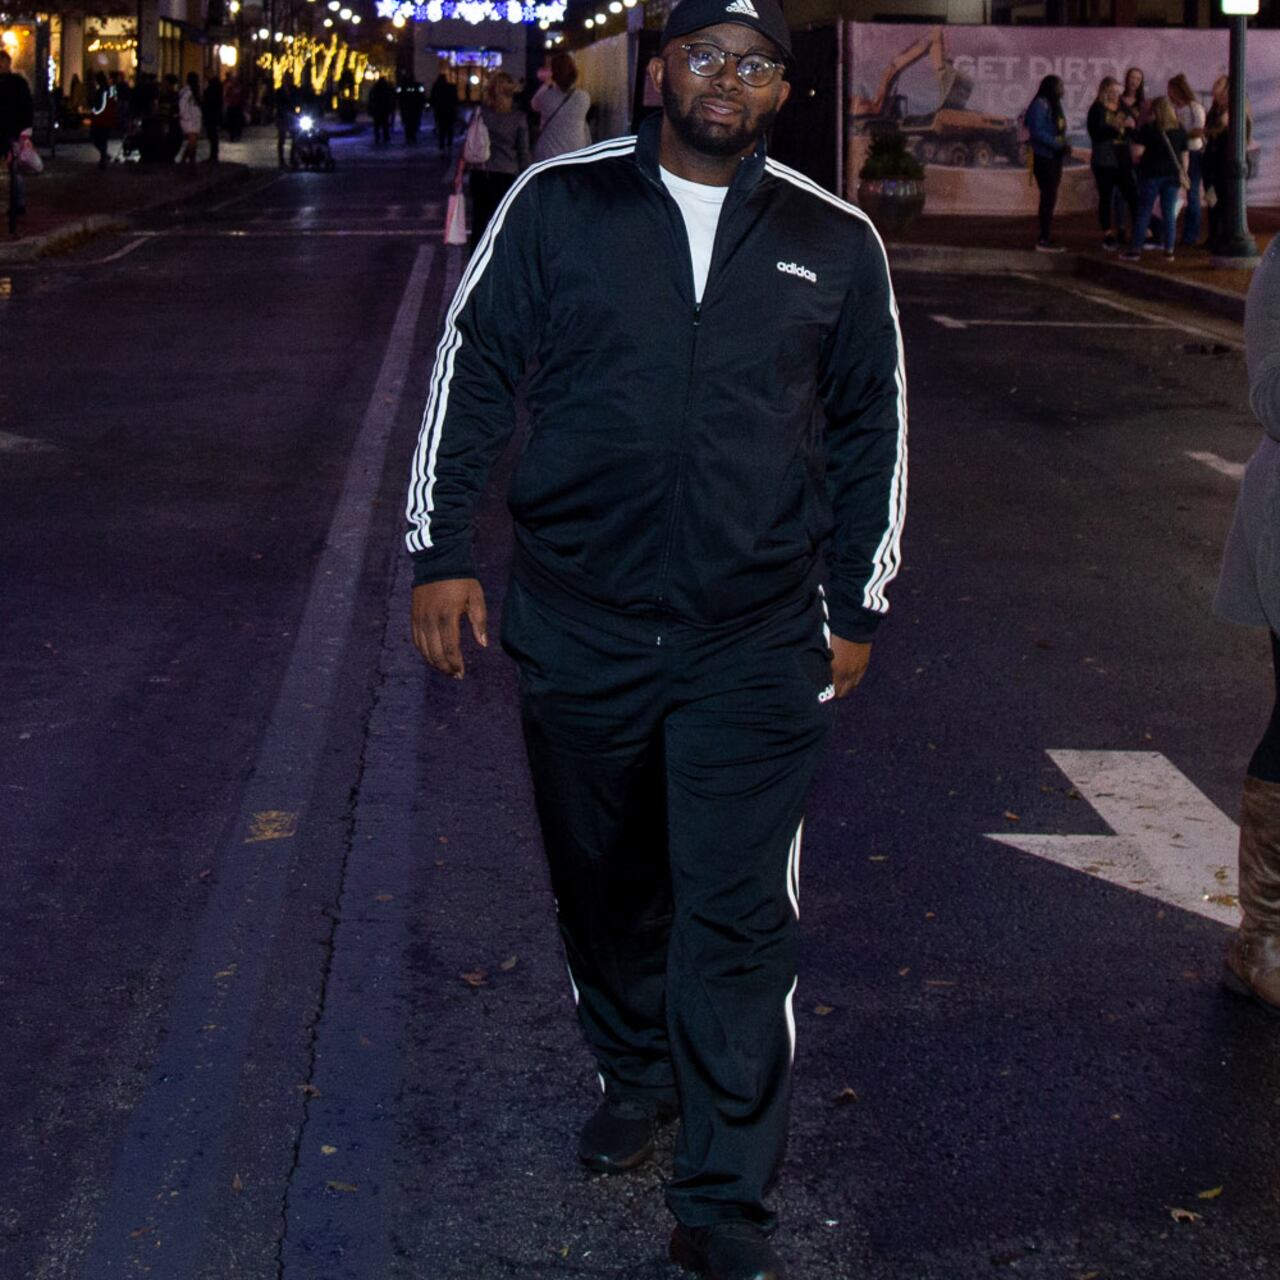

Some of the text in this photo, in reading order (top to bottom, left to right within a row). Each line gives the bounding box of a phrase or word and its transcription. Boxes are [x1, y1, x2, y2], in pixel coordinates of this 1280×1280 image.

[953, 54, 1133, 82] GET DIRTY
[776, 260, 818, 283] adidas
